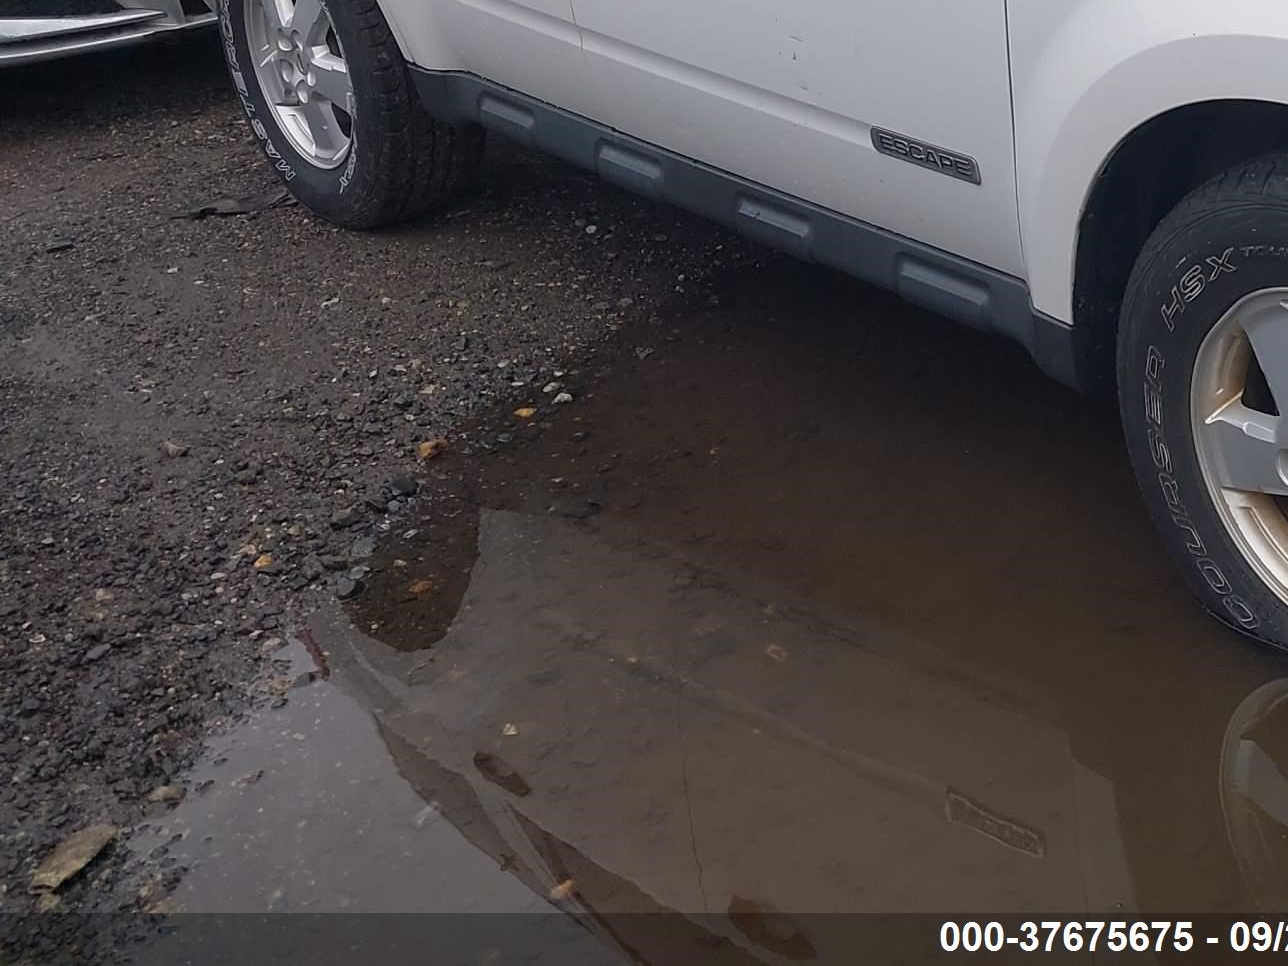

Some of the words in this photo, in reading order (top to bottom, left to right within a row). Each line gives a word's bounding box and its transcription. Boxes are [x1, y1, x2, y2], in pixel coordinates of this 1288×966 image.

[879, 132, 972, 176] ESCAPE
[1160, 246, 1237, 332] HSX
[1144, 344, 1260, 631] COURSER
